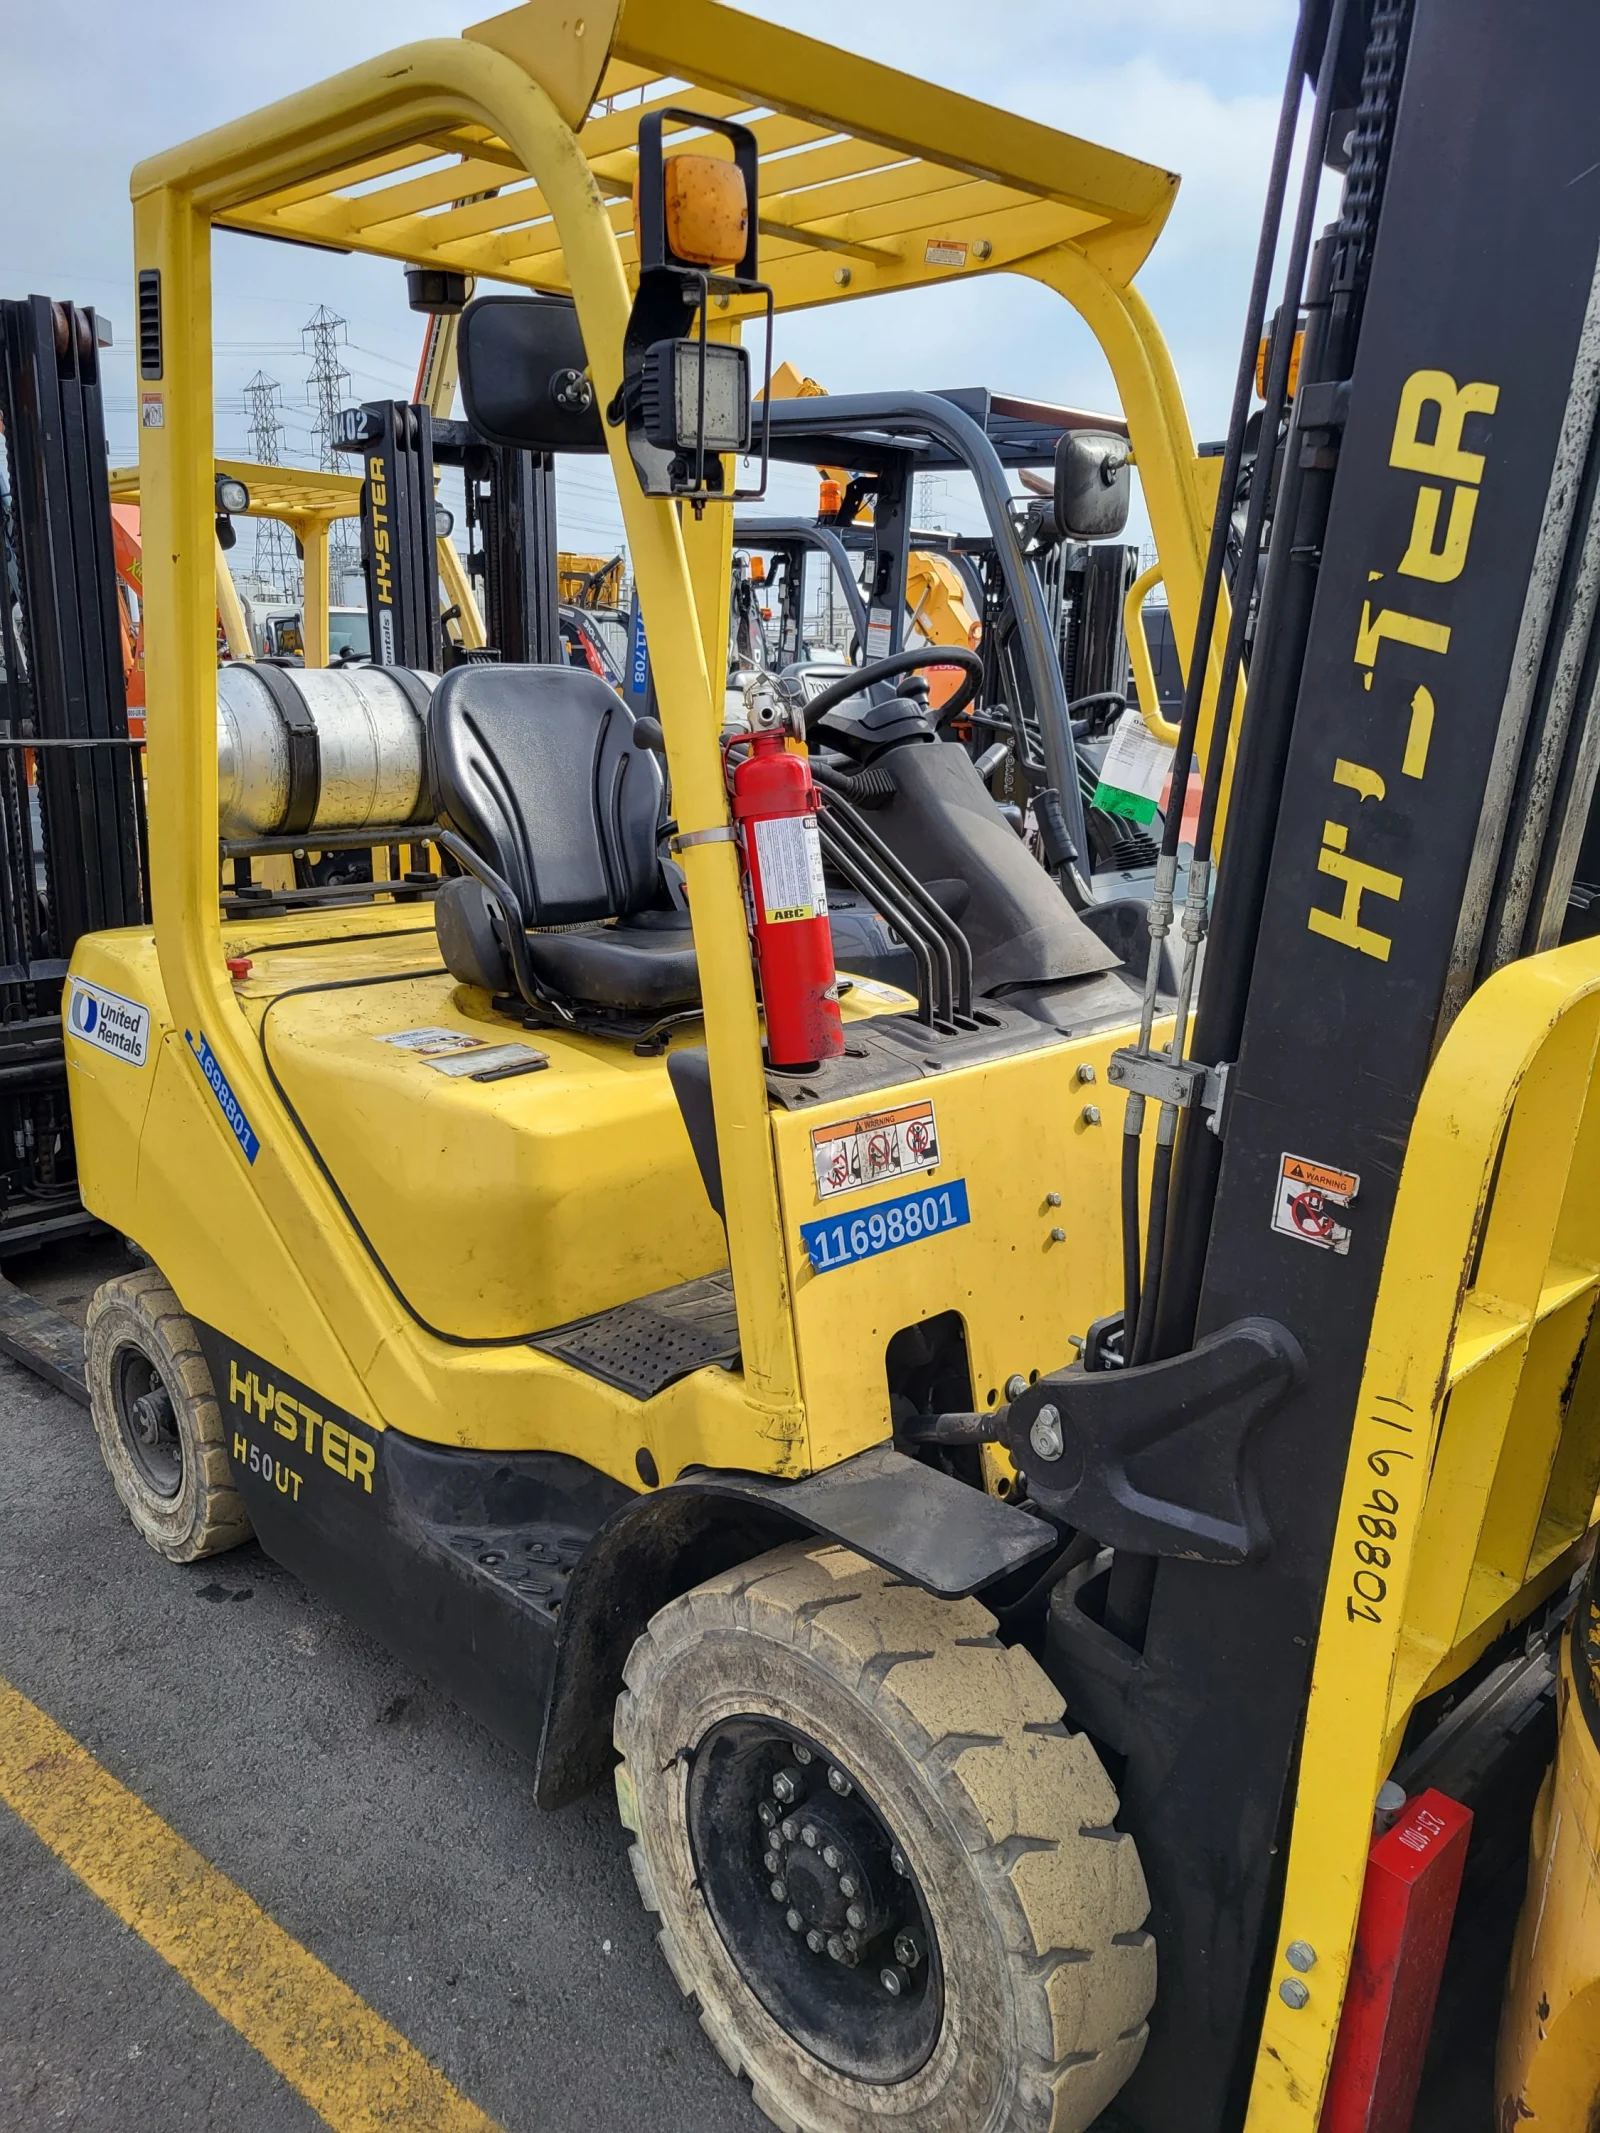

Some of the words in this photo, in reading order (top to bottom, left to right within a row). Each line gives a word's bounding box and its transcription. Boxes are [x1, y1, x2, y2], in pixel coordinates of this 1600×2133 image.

[369, 457, 393, 604] HYSTER
[383, 617, 392, 667] entals
[774, 908, 804, 921] ABC
[97, 1020, 142, 1057] Rentals
[100, 1002, 141, 1033] United
[190, 1040, 252, 1153] 1698801
[863, 1115, 896, 1130] WARNING
[1306, 1171, 1347, 1191] WARNING
[815, 1191, 957, 1269] 11698801
[229, 1359, 375, 1494] HYSTER
[233, 1431, 304, 1502] H50UT
[1346, 1395, 1414, 1624] 11698801
